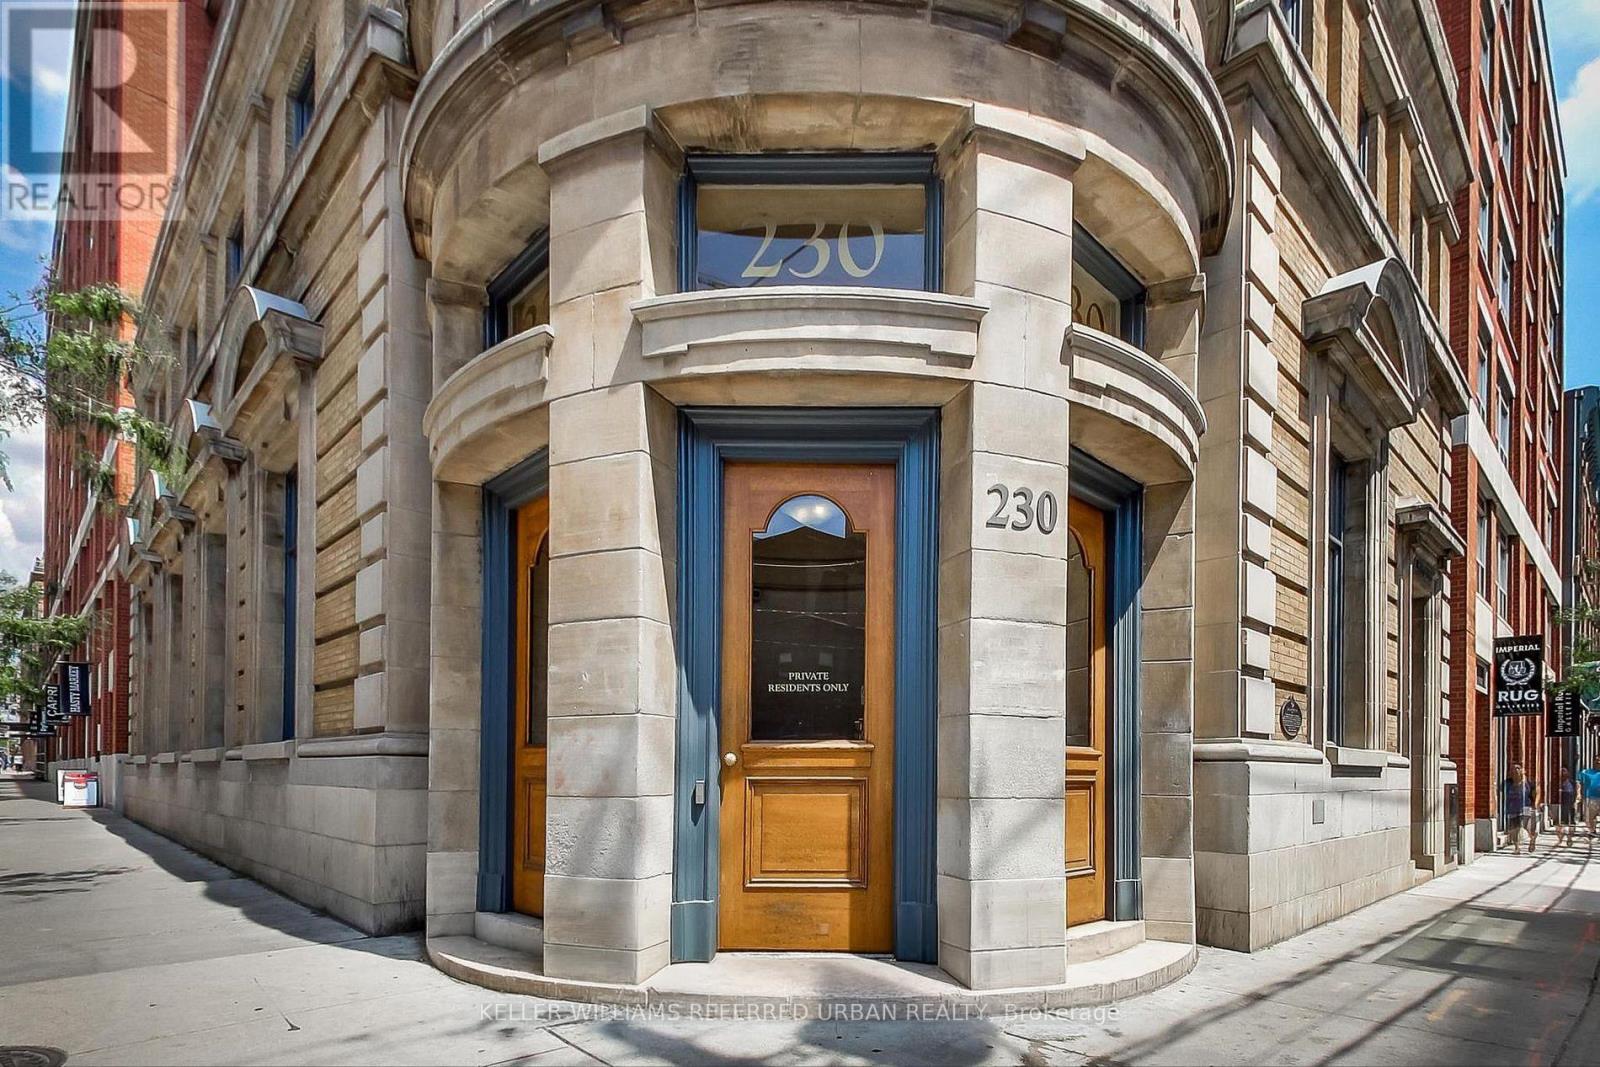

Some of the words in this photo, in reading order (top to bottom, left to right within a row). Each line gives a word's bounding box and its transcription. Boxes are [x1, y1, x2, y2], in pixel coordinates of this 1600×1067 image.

[741, 218, 885, 278] 230
[985, 483, 1058, 535] 230
[1495, 643, 1541, 654] IMPERIAL
[68, 665, 80, 691] MARKET
[768, 683, 821, 693] RESIDENTS
[822, 683, 849, 693] ONLY
[788, 672, 829, 681] PRIVATE
[46, 686, 58, 717] CAPRI
[69, 691, 81, 712] HASTY
[1498, 689, 1540, 702] RUG
[1554, 702, 1566, 733] Imperial
